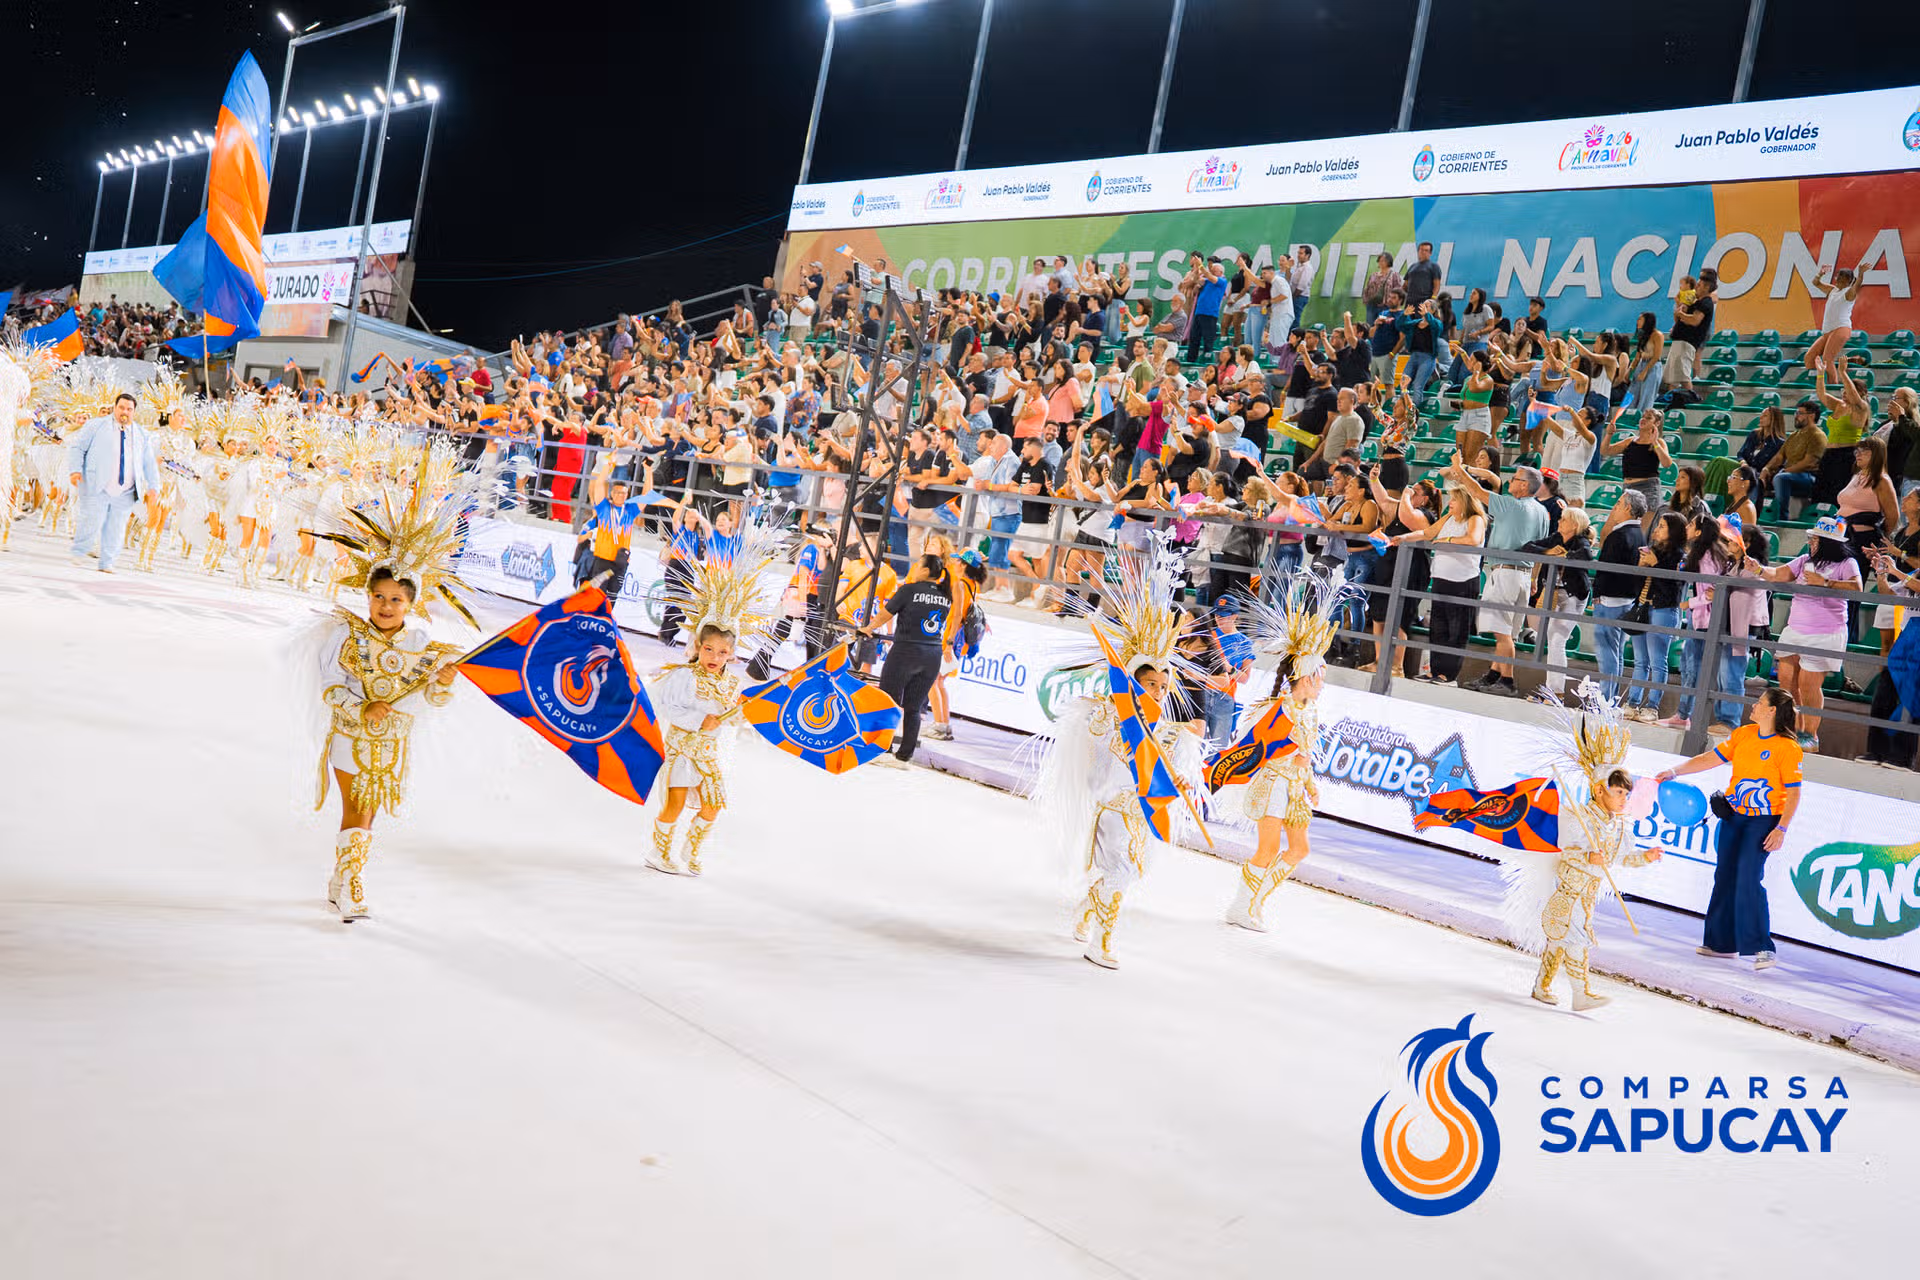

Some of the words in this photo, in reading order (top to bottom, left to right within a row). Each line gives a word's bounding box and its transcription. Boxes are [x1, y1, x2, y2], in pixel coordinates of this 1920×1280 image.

[1674, 133, 1713, 149] Juan
[1714, 127, 1761, 146] Pablo
[1764, 121, 1820, 142] Valdés
[1440, 151, 1483, 162] GOBIERNO
[1484, 150, 1497, 159] DE
[1760, 142, 1816, 154] GOBERNADOR
[1265, 163, 1292, 177] Juan
[1293, 159, 1322, 174] Pablo
[1324, 156, 1360, 172] Valdés
[1321, 173, 1357, 182] GOBERNADOR
[1438, 160, 1508, 174] CORRIENTES
[983, 185, 1002, 196] Juan
[1002, 184, 1024, 196] Pablo
[1025, 181, 1051, 193] Valdés
[1103, 183, 1152, 195] CORRIENTES
[273, 274, 320, 299] JURADO
[960, 652, 1026, 688] BanCo
[538, 692, 593, 733] SAPUCAY
[786, 718, 828, 747] SAPUCAY
[1337, 717, 1405, 746] distribuidora
[1312, 733, 1431, 799] JotaBe
[1632, 799, 1721, 857] Ban
